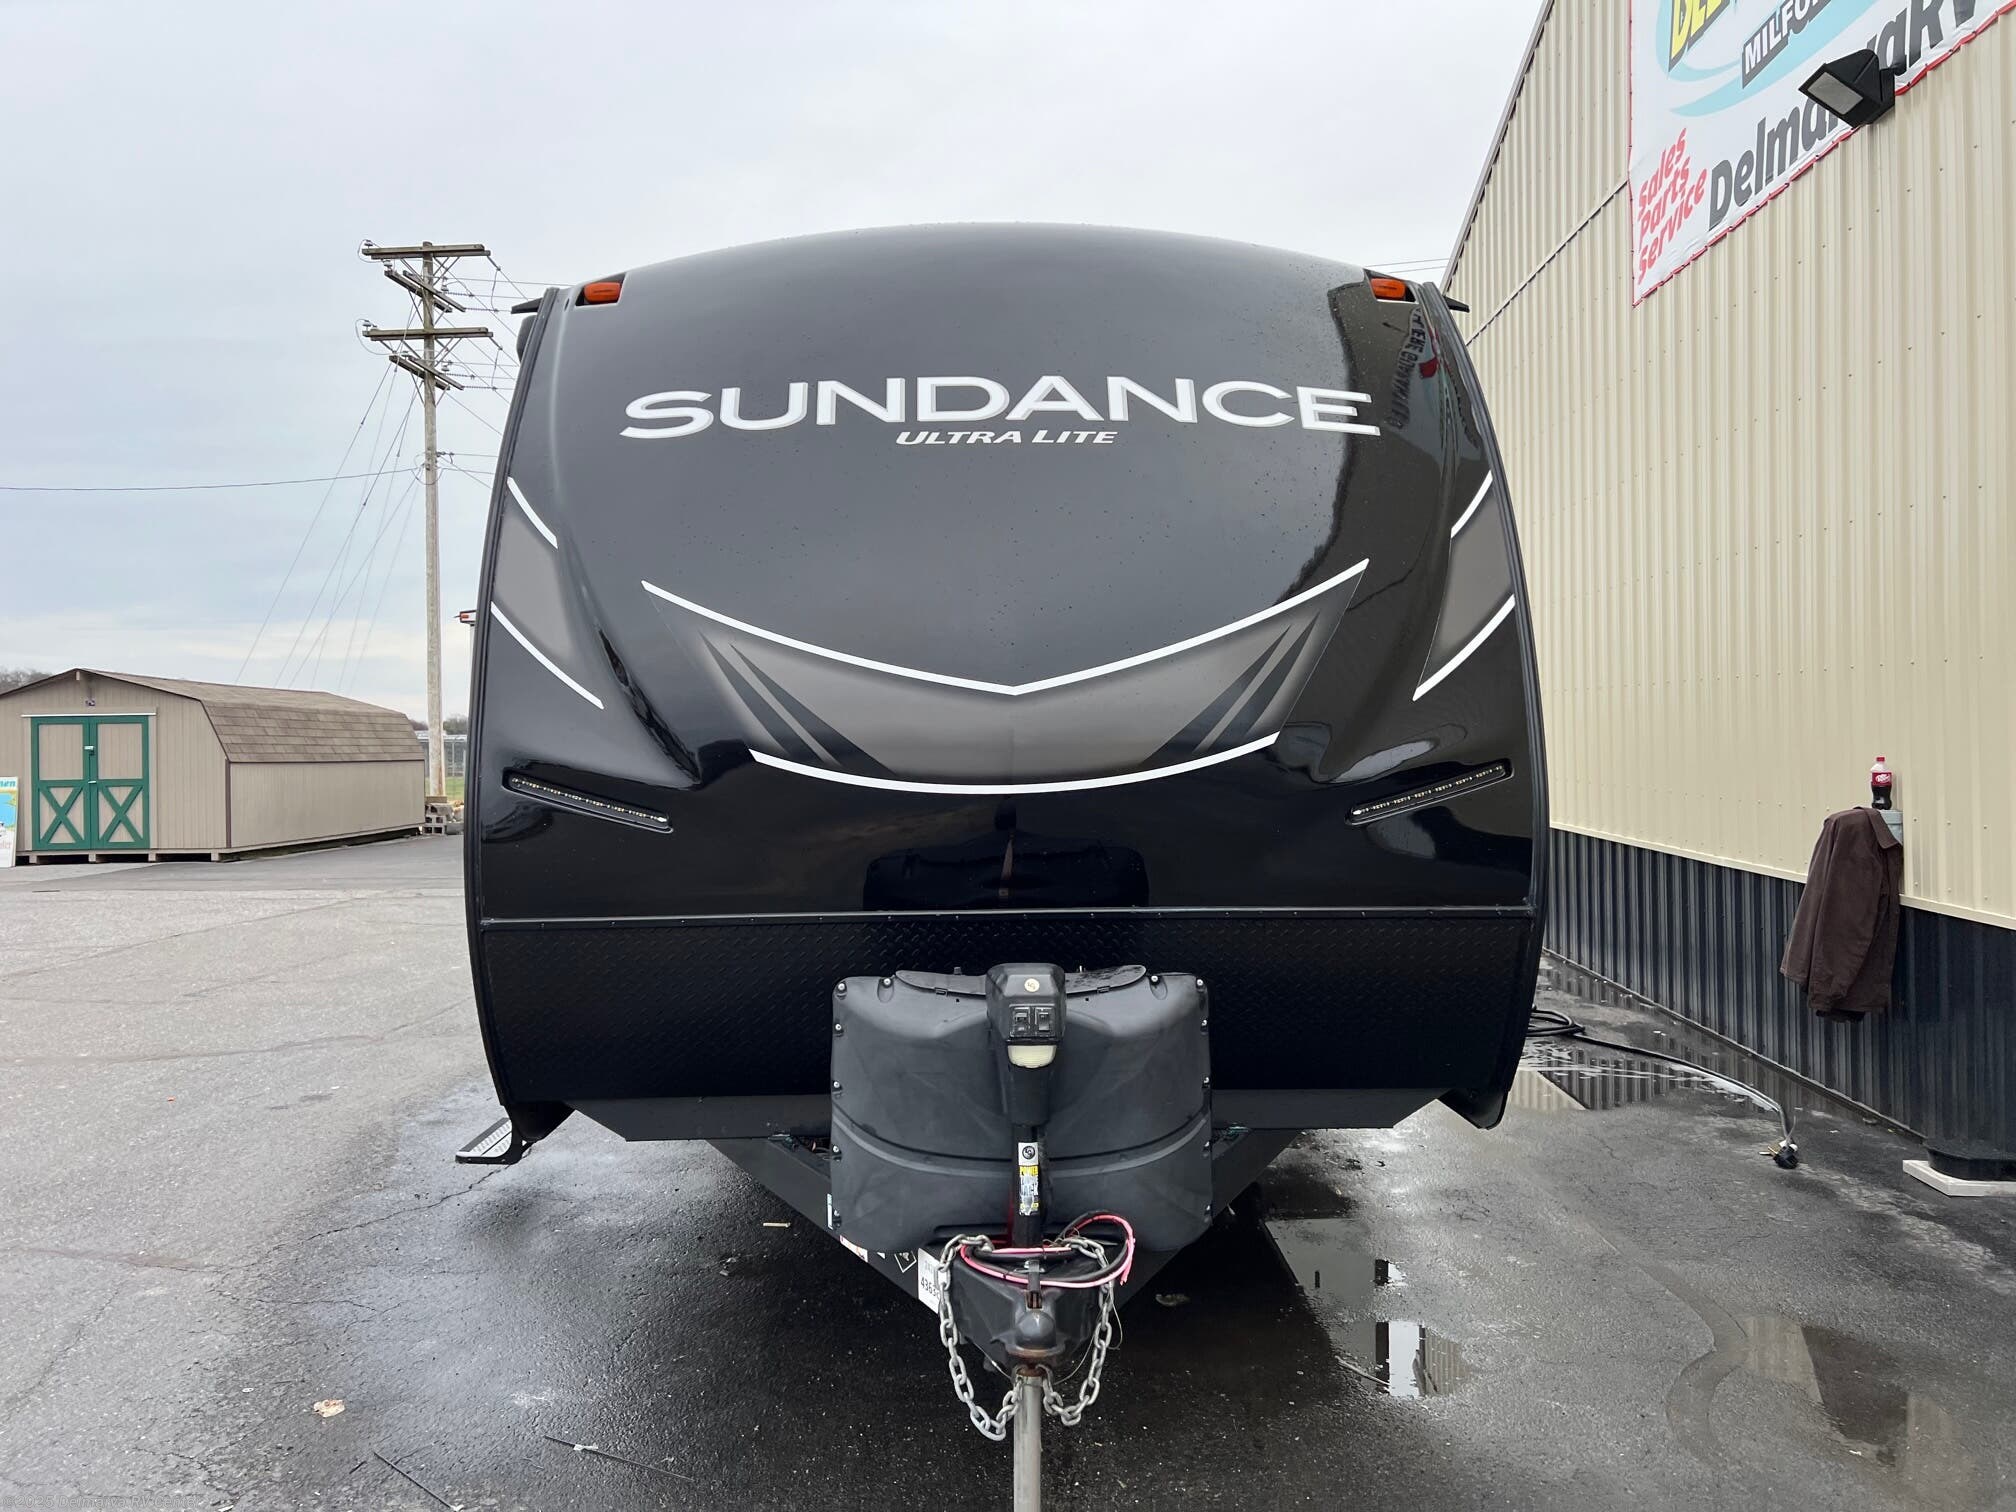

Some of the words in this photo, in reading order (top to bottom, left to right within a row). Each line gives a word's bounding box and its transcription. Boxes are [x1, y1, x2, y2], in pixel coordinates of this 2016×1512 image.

[1744, 0, 1819, 75] MILFO
[618, 374, 1381, 439] SUNDANCE
[896, 430, 1022, 445] ULTRA
[1031, 429, 1118, 444] LITE
